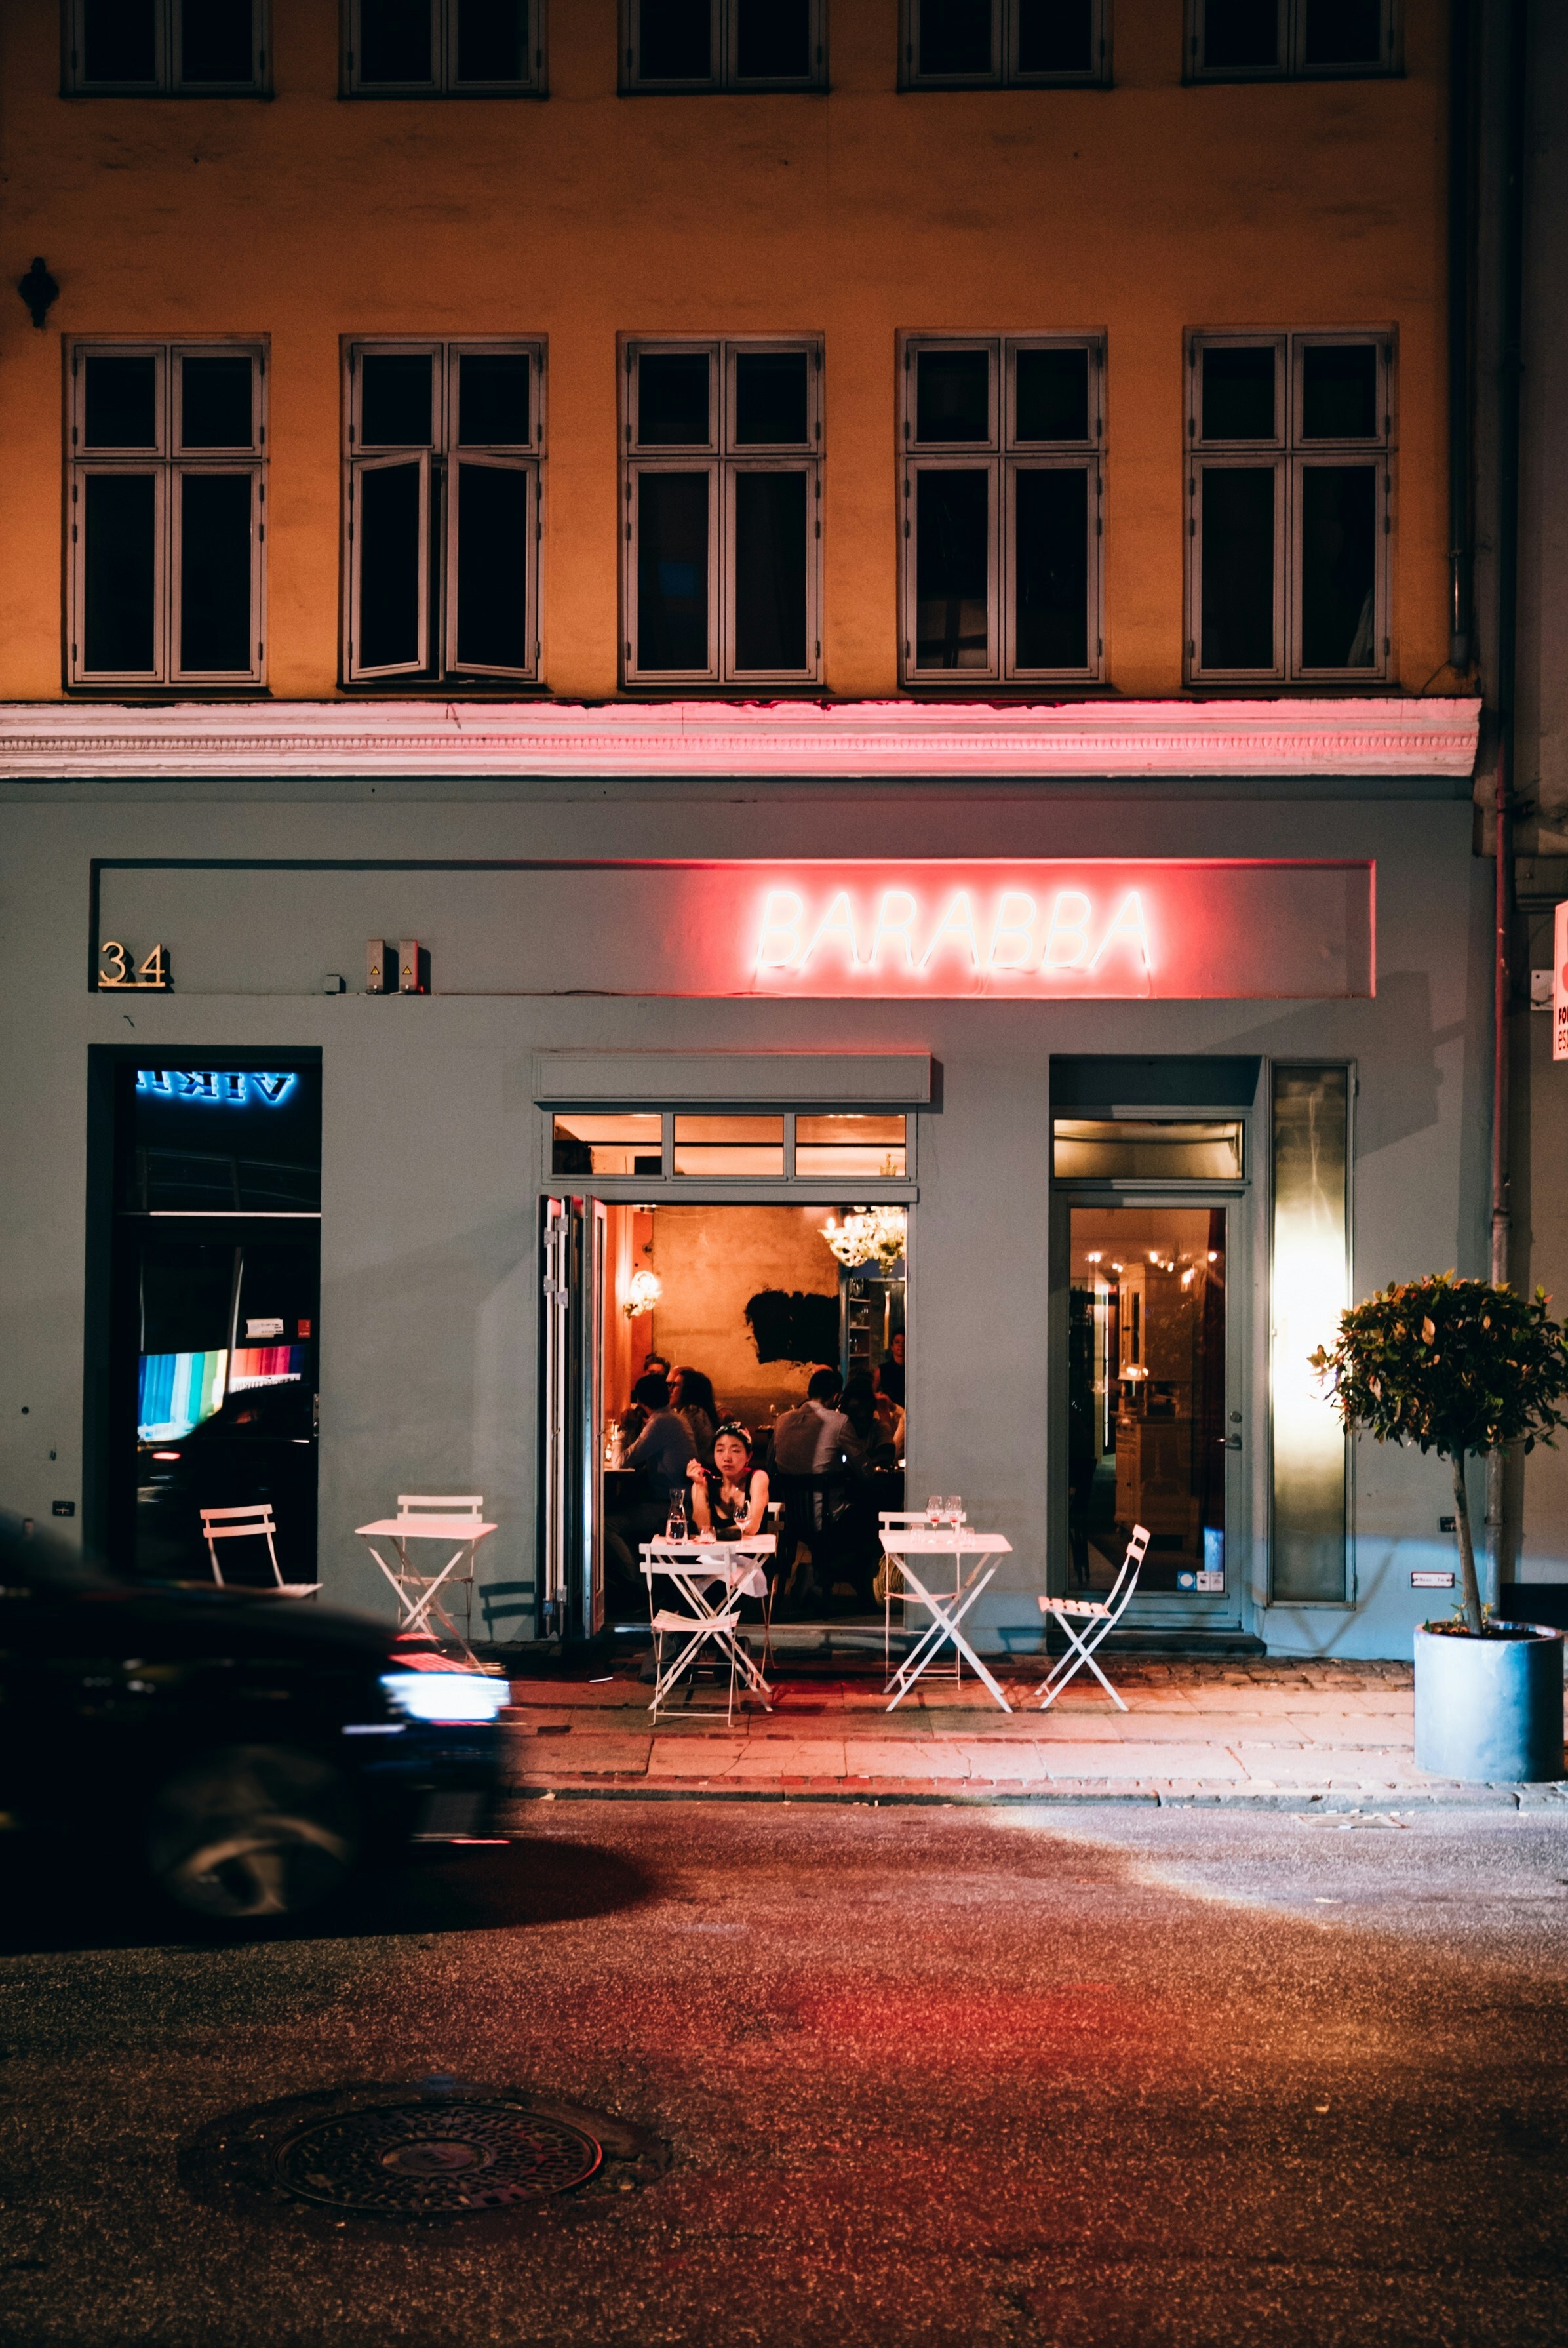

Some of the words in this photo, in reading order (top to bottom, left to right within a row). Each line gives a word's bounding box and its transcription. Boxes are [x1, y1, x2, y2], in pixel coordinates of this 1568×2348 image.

[756, 890, 1151, 969] BARABBA
[100, 941, 165, 984] 34
[1558, 1006, 1568, 1025] FO
